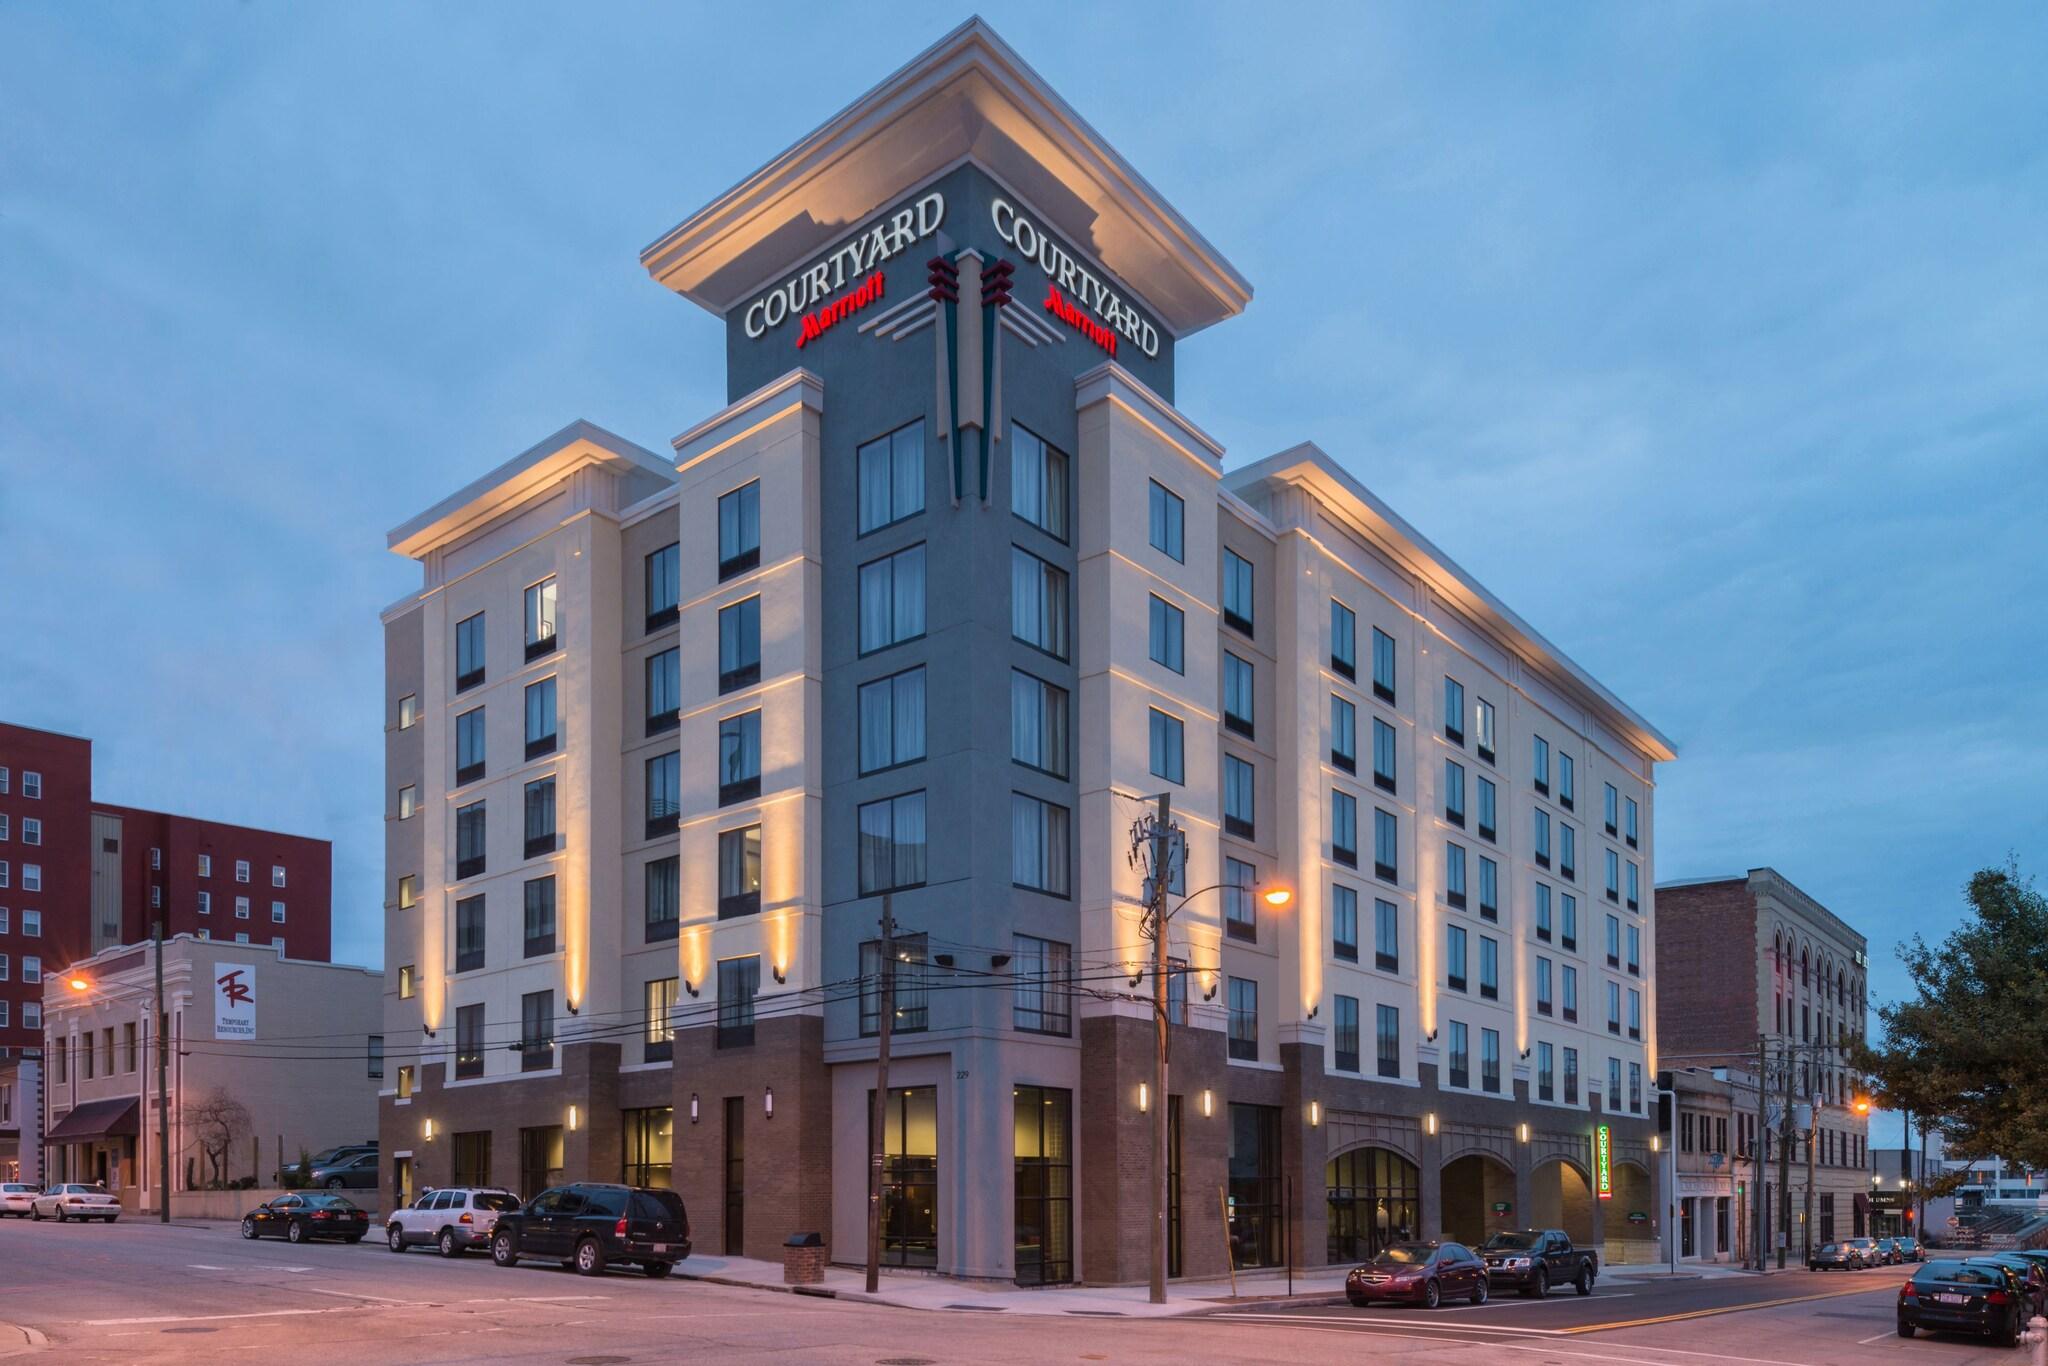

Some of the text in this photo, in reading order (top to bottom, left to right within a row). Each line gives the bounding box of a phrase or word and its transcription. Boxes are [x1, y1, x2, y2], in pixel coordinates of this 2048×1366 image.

[744, 192, 945, 338] COURTYARD
[992, 199, 1160, 357] COURTYARD
[797, 271, 884, 348] Marriott
[1045, 285, 1118, 356] Marriott
[1599, 1126, 1609, 1190] COURTYARD
